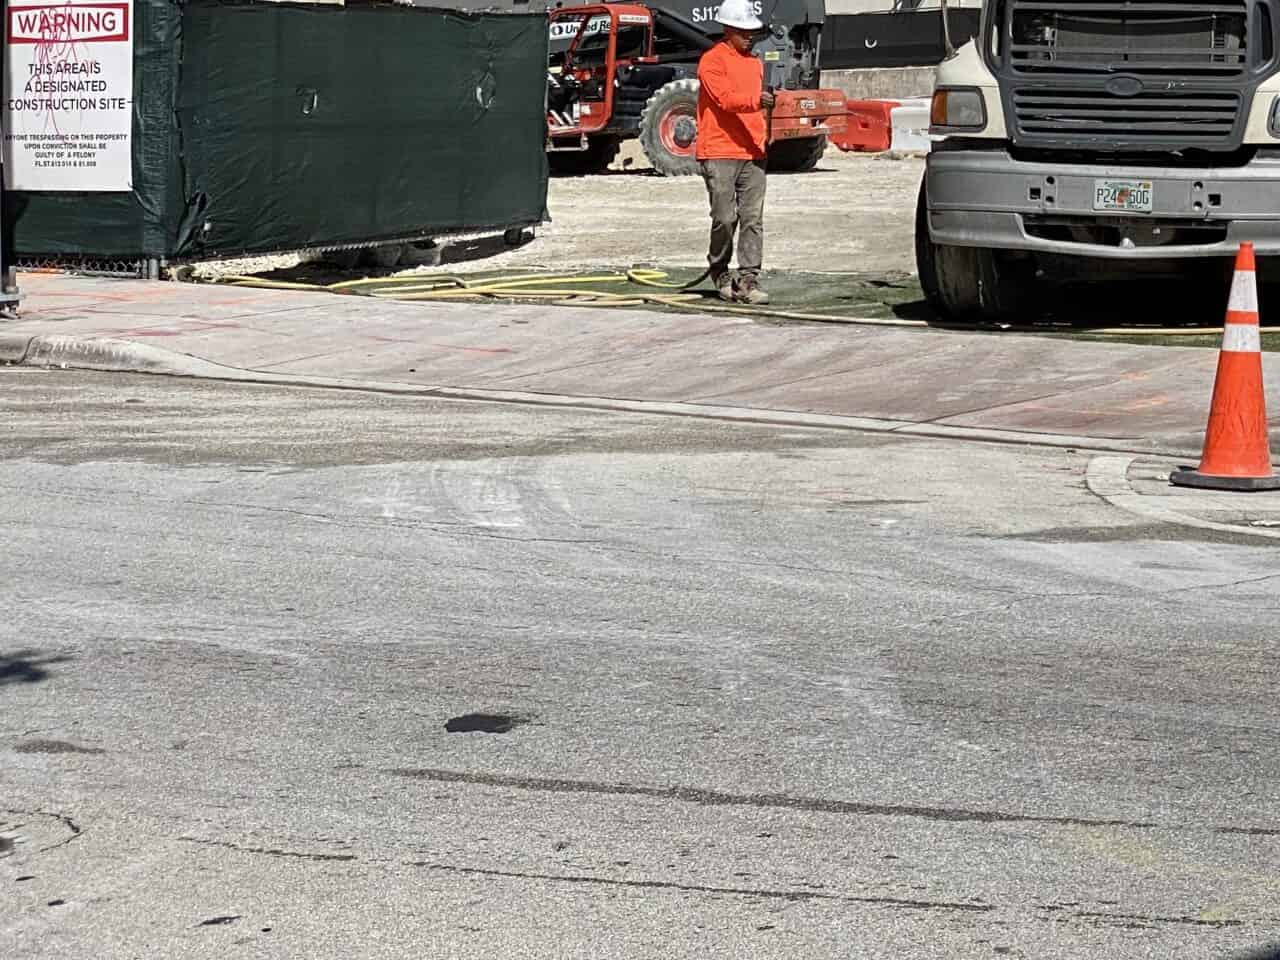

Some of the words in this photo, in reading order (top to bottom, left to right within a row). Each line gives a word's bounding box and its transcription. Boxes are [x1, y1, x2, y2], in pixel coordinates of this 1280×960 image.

[17, 11, 116, 33] WARNING
[28, 63, 52, 75] THIS
[55, 62, 87, 74] AREA
[90, 62, 101, 73] IS
[25, 81, 32, 93] A
[35, 80, 107, 93] DESIGNATED
[8, 98, 97, 110] CONSTRUCTION
[99, 98, 126, 109] SITE
[42, 142, 77, 150] CONVICTION
[79, 142, 97, 150] SHALL
